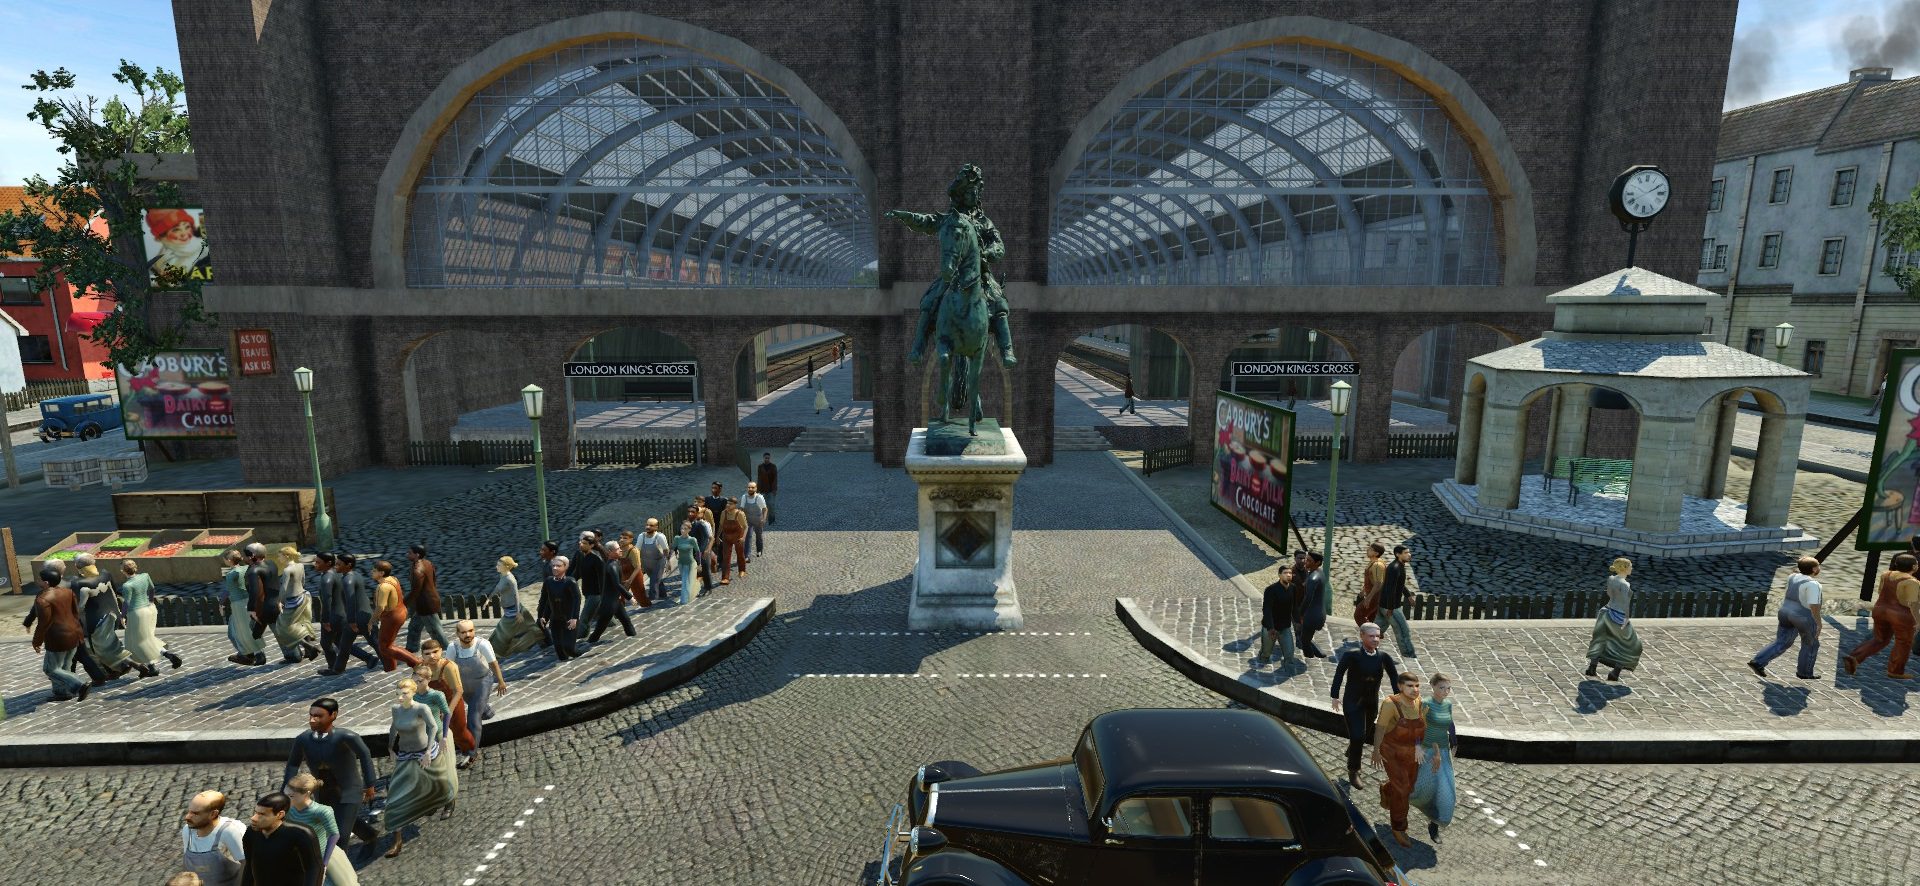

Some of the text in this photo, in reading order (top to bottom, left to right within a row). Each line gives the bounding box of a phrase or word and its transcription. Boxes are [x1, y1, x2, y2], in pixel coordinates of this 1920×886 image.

[240, 334, 267, 344] AS YOU
[241, 348, 269, 358] TRAVEL
[244, 360, 271, 371] ASK US
[570, 365, 690, 375] LONDON KING'S CROSS
[1239, 364, 1355, 374] LONDON KING'S CROSS
